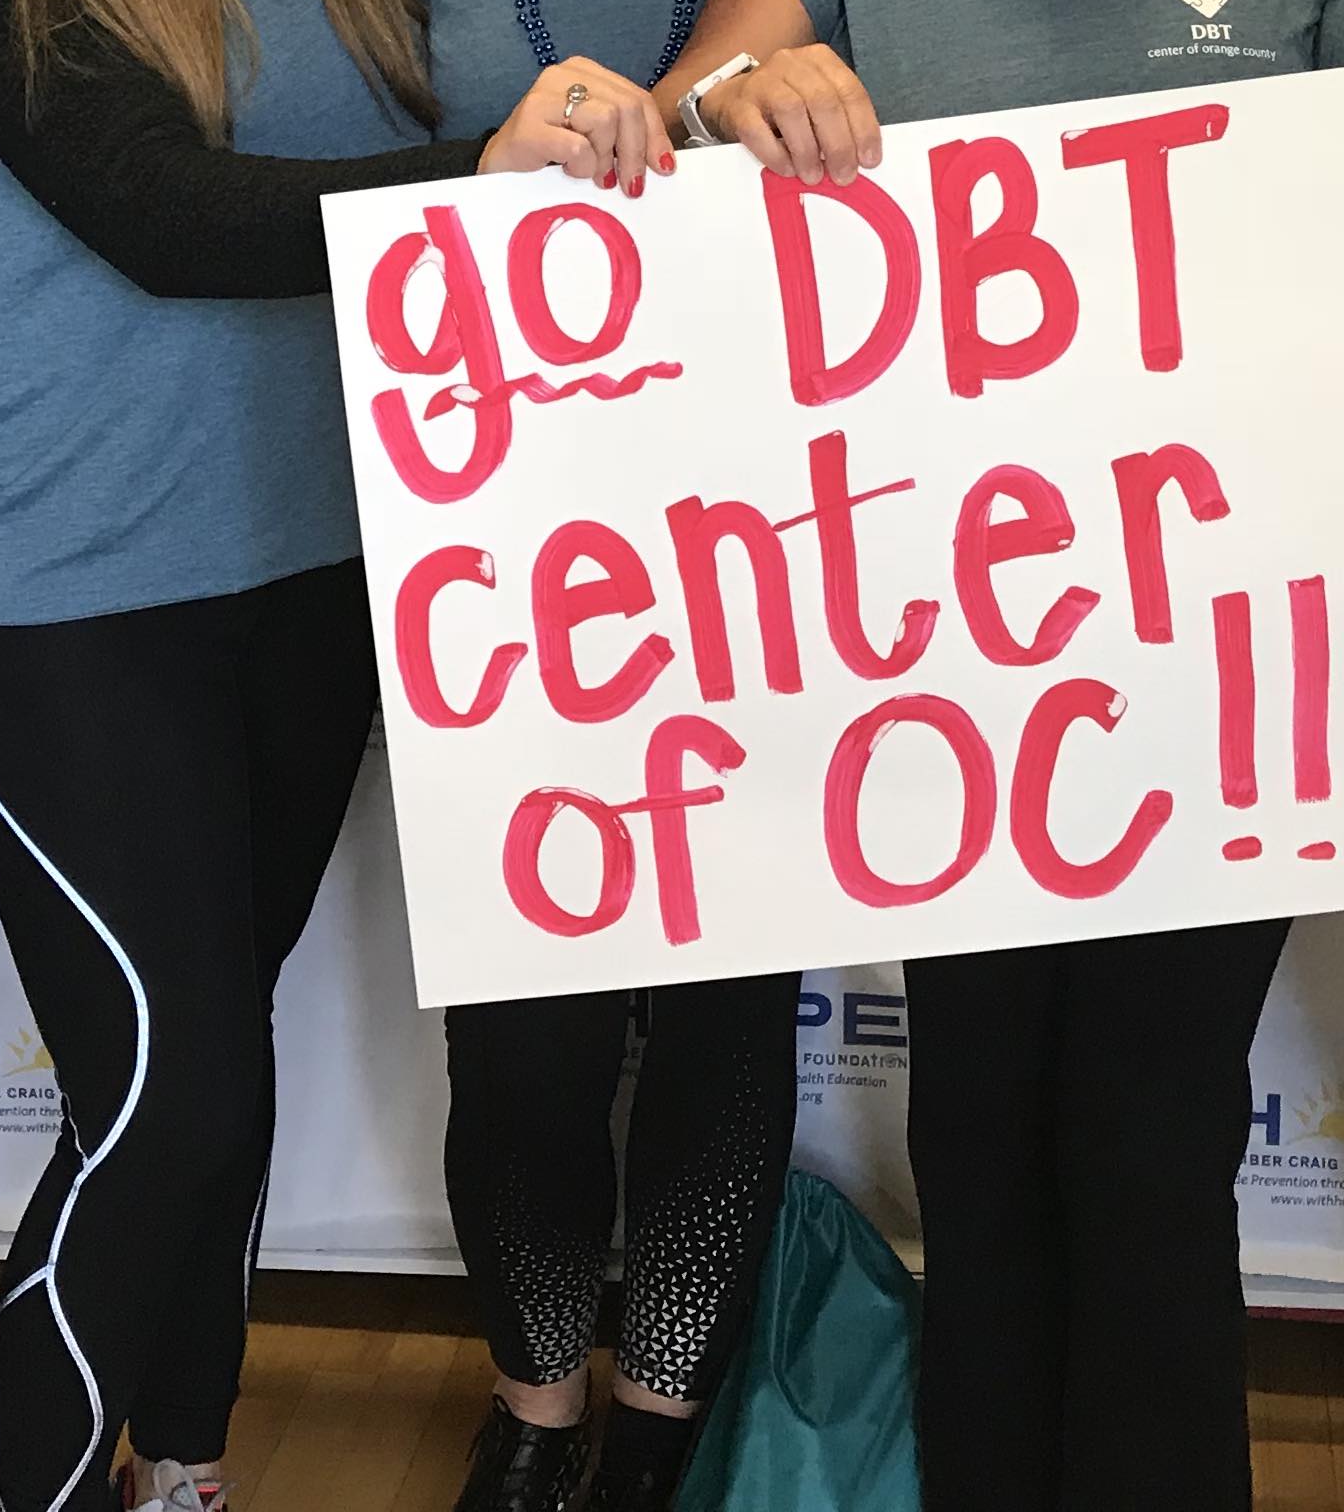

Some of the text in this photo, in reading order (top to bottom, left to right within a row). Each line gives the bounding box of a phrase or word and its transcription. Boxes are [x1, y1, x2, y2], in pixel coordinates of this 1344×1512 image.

[1191, 24, 1233, 40] DBT
[1147, 43, 1276, 62] center of orange county
[366, 102, 1231, 503] go DBT
[395, 430, 1231, 728] center
[503, 714, 748, 947] of
[827, 1073, 887, 1088] Education
[7, 1087, 55, 1100] CRAIG
[1289, 1156, 1338, 1170] CRAIG
[1251, 1174, 1318, 1188] Prevention
